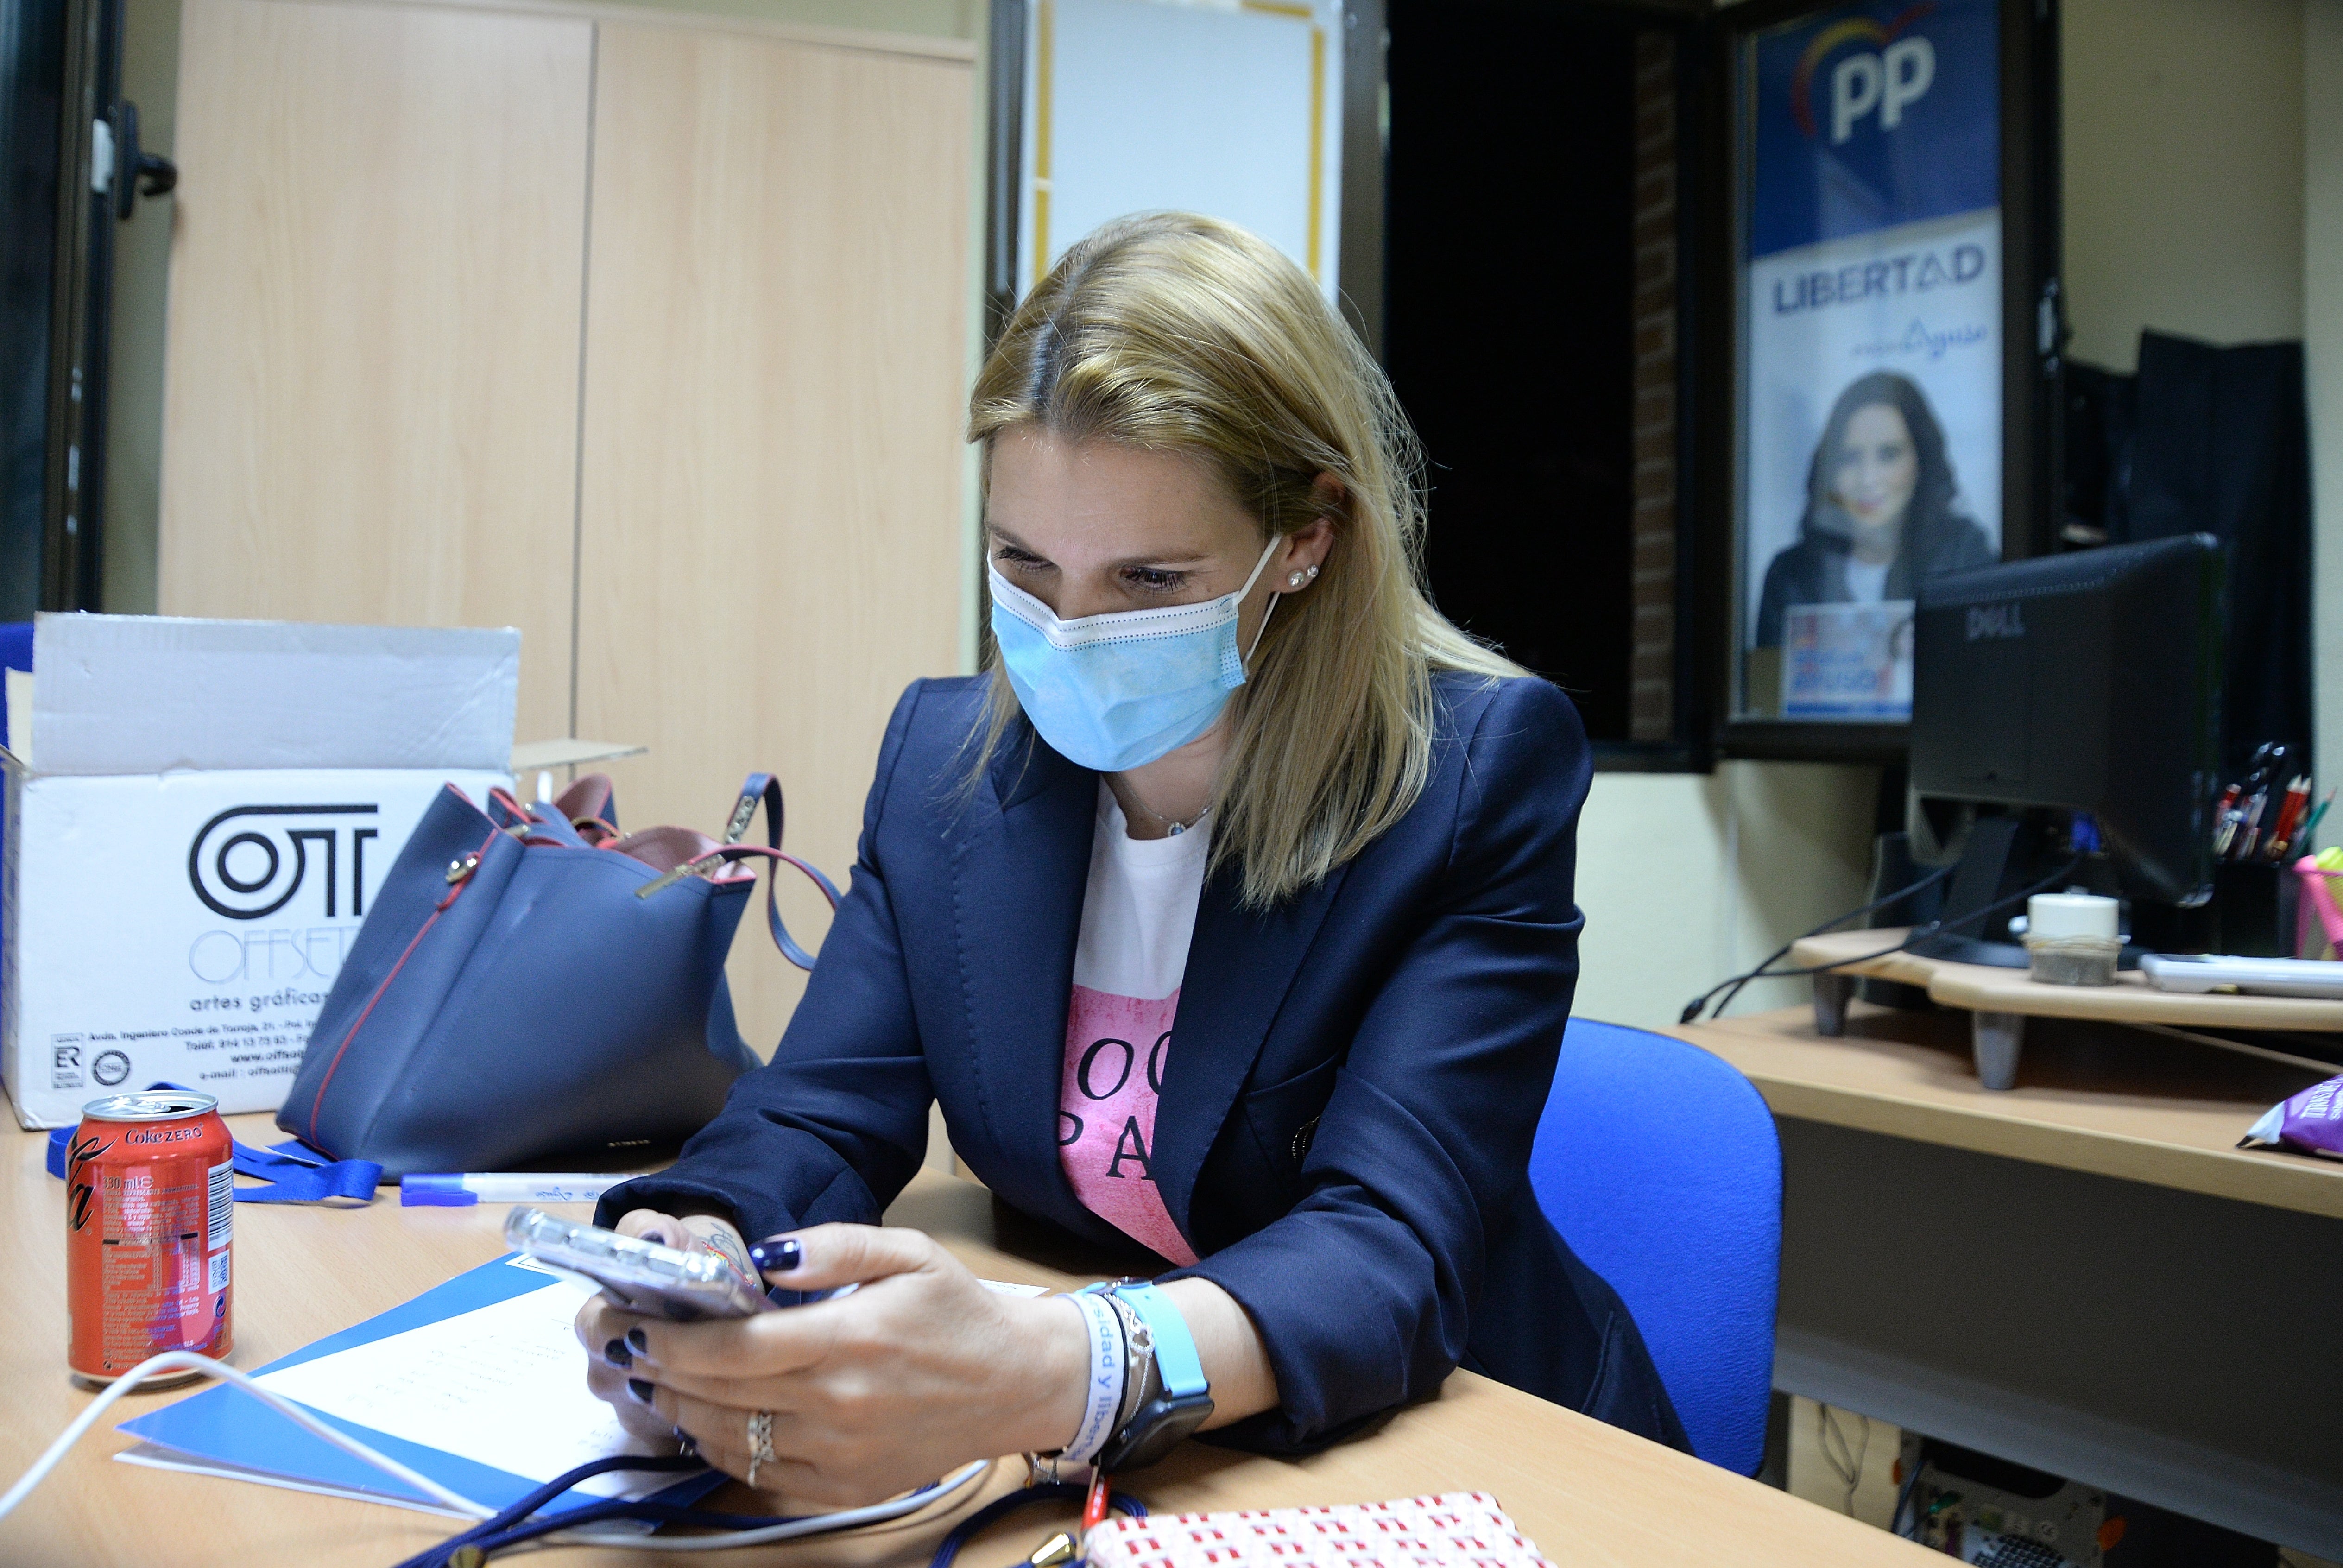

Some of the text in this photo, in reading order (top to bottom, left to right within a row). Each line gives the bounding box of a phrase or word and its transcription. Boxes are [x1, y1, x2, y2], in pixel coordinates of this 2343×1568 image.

[1774, 243, 1986, 316] LIBERTAD
[190, 995, 240, 1011] artes
[120, 1029, 167, 1040] Ingeniero
[126, 1126, 203, 1144] Coke ZERO
[103, 1176, 121, 1189] 330
[1098, 1376, 1111, 1389] y
